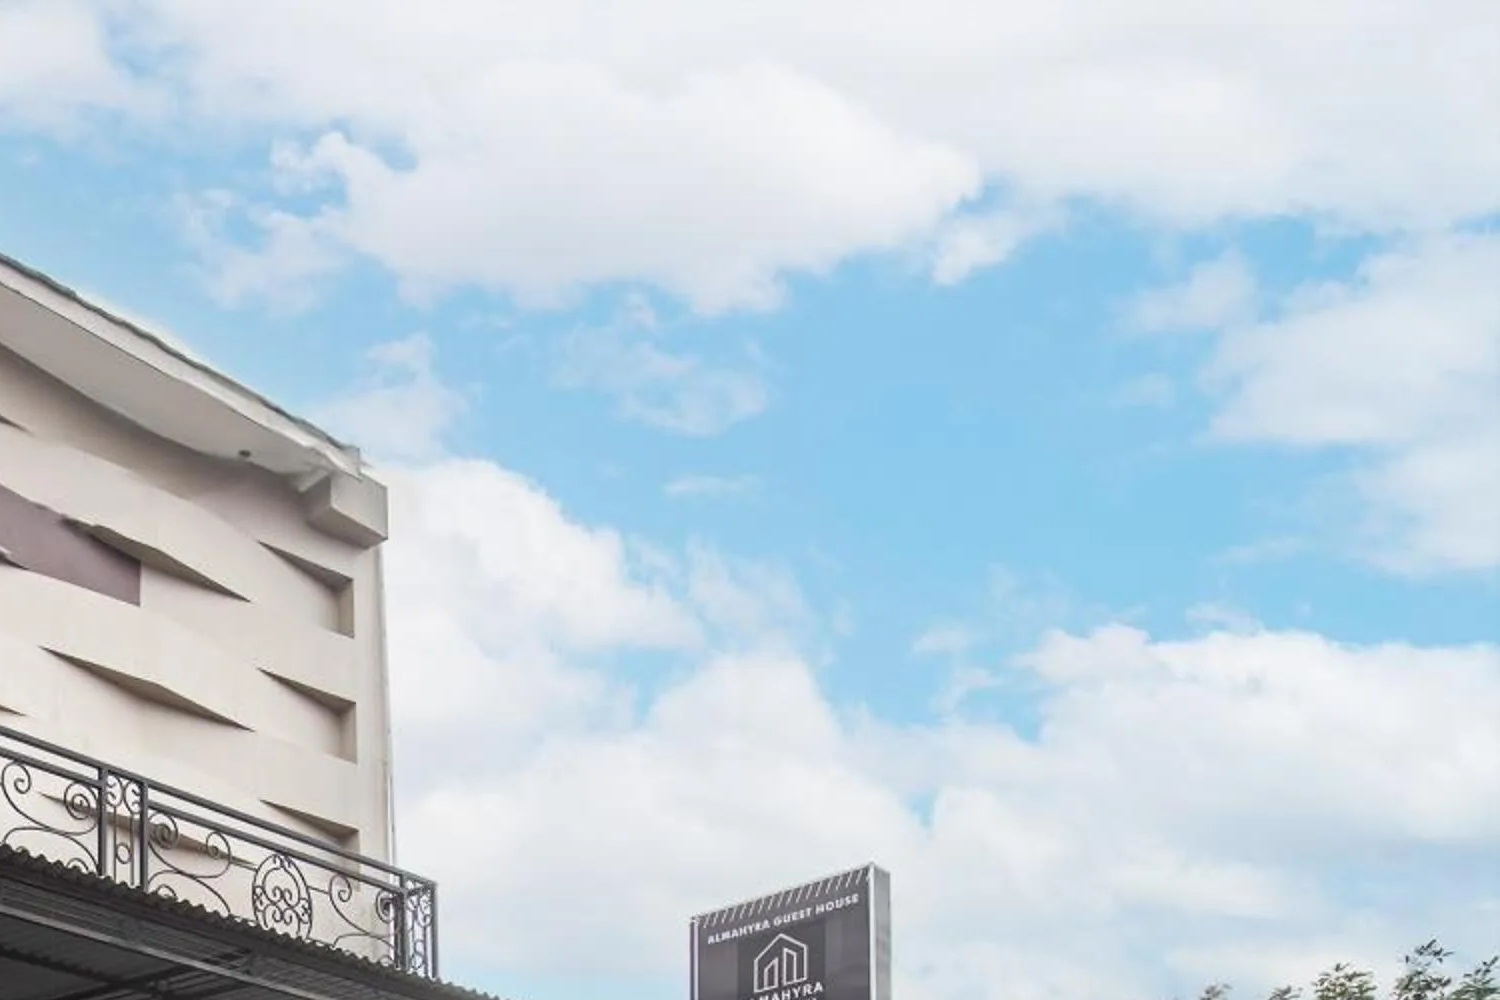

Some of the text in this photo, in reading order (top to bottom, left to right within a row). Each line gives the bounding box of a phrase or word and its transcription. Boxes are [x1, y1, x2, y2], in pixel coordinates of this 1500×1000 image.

[707, 893, 859, 945] ALMAHYRA GUEST HOUSE
